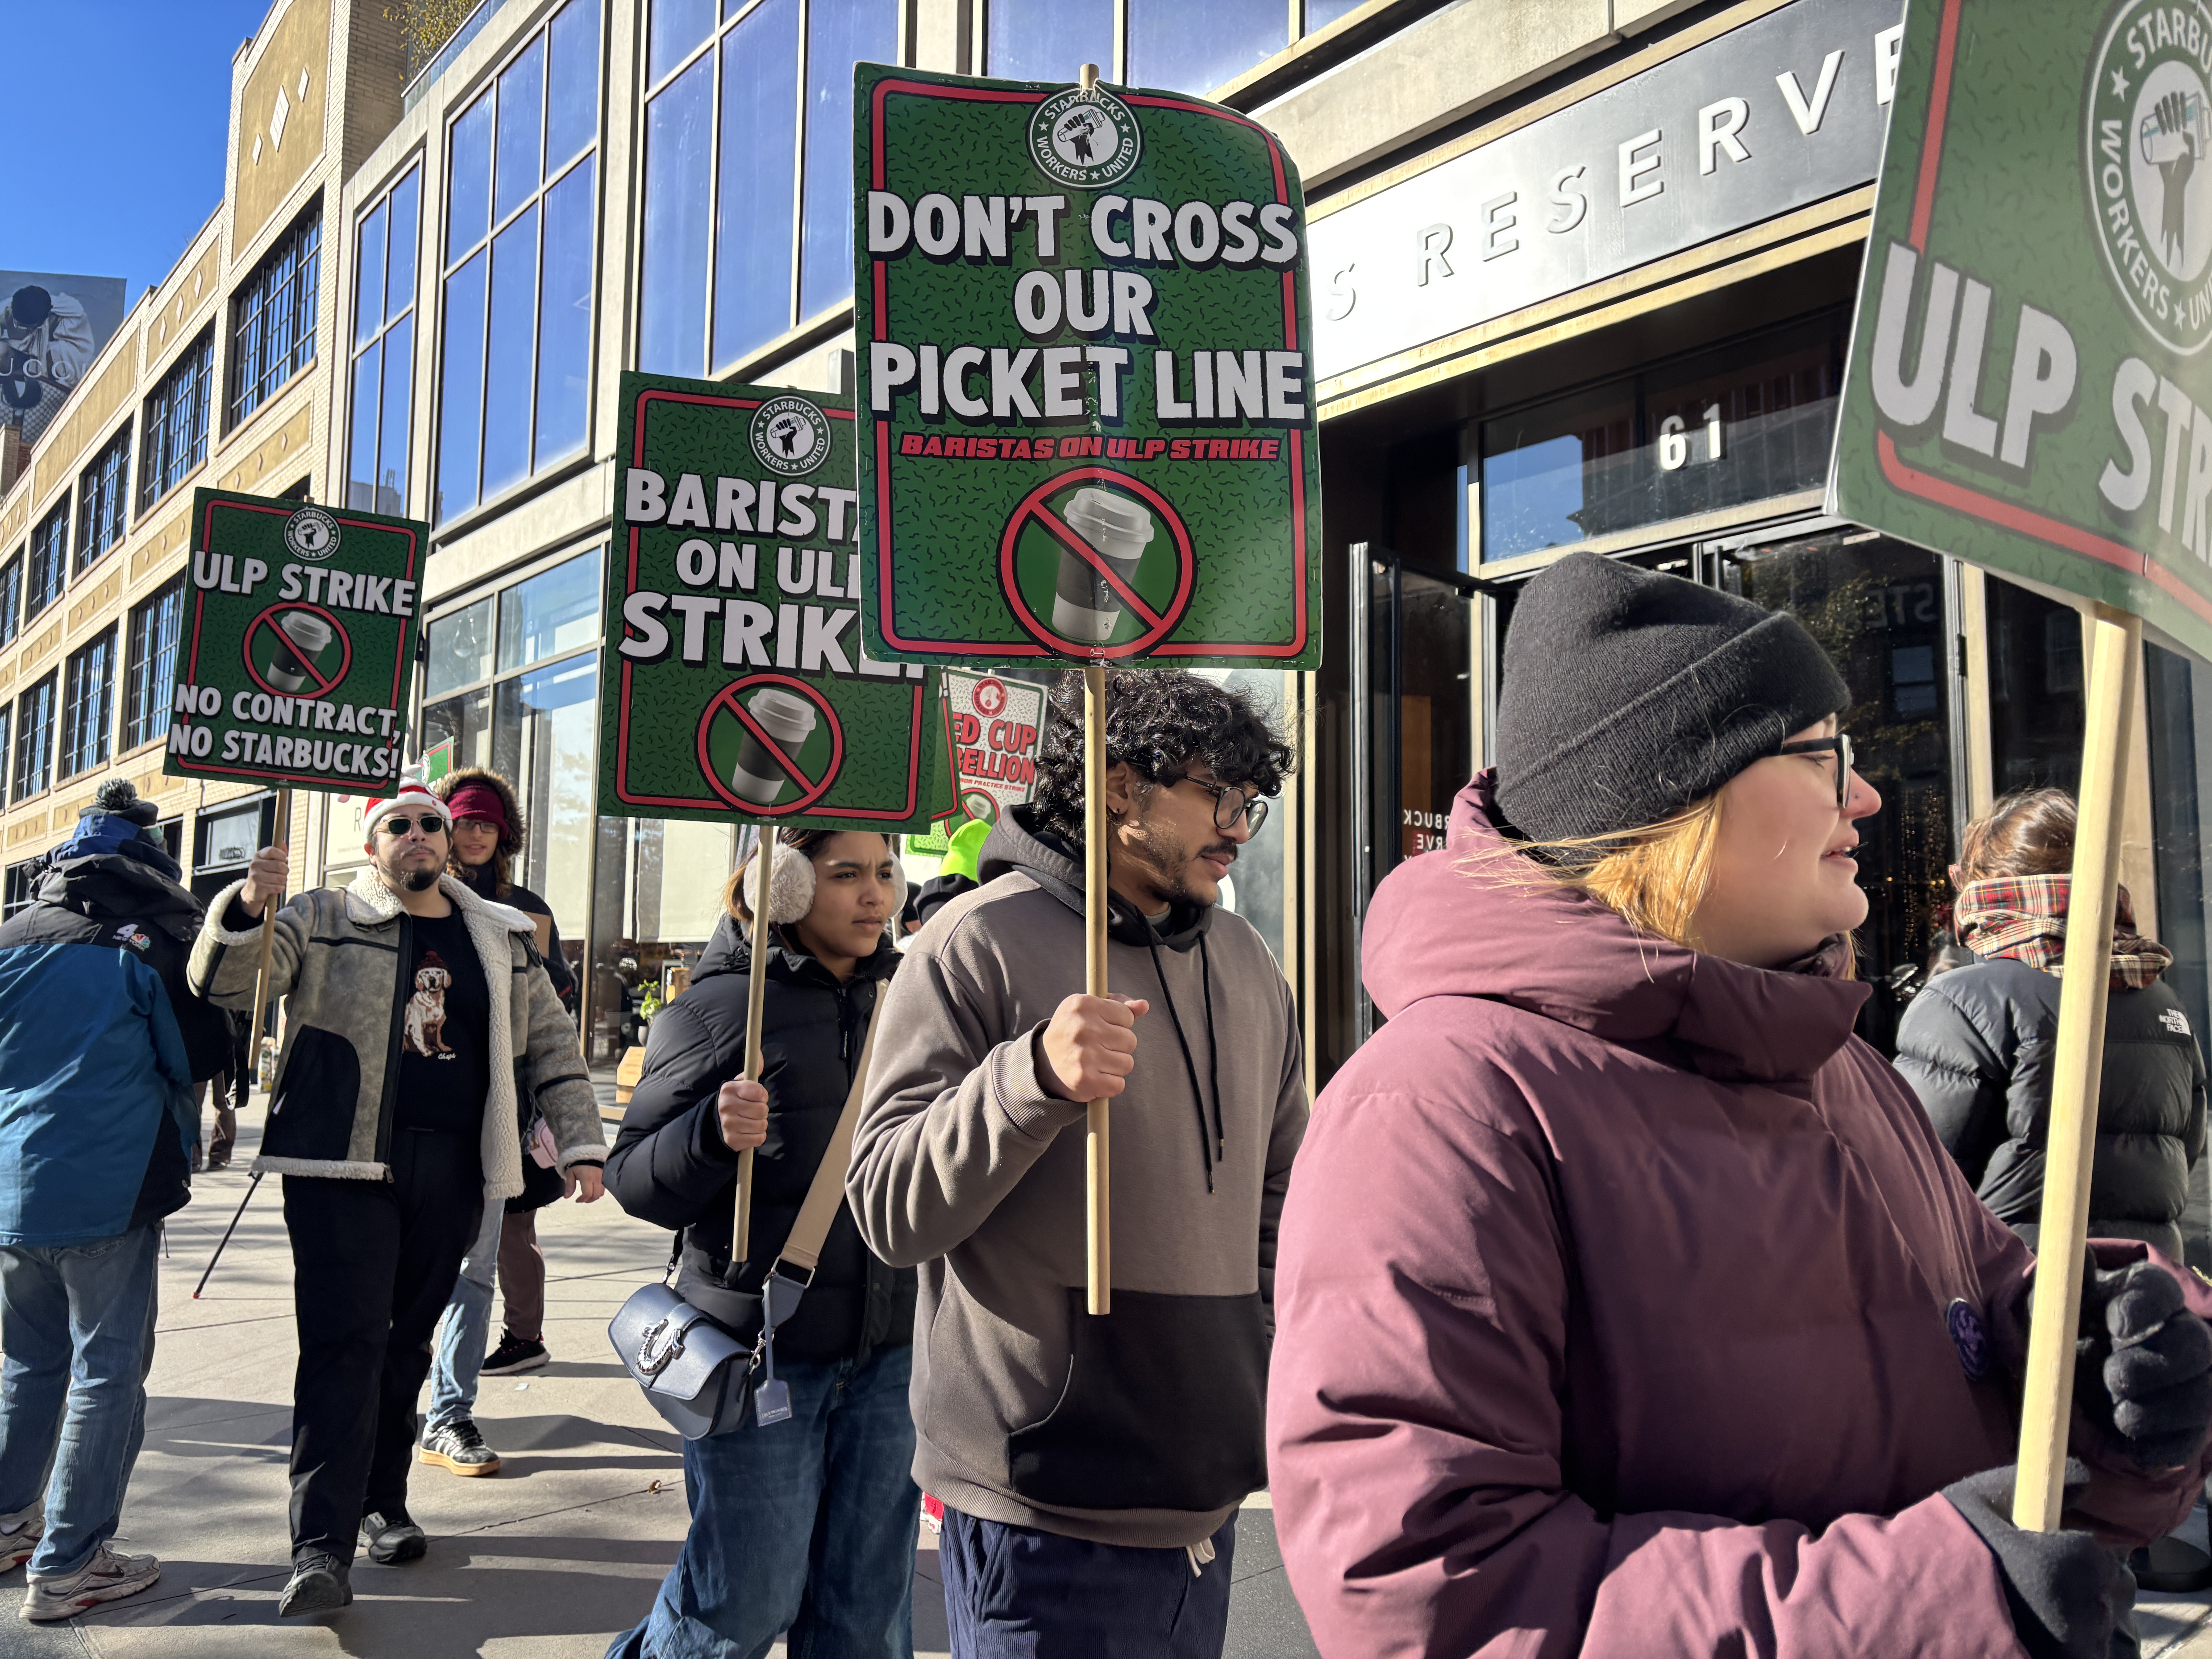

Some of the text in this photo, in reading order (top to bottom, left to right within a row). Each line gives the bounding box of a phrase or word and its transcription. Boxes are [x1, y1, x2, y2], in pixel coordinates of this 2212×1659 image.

[1044, 90, 1125, 121] STARBUCKS
[1037, 136, 1133, 180] WORKERS UNITED
[868, 191, 1298, 263] DON'T CROSS
[2101, 120, 2169, 319] WORKERS
[1015, 270, 1152, 335] OUR
[868, 342, 1305, 419] PICKET LINE
[1872, 241, 2212, 568] ULP STR
[763, 401, 821, 425] STARBUCKS
[1659, 404, 1722, 470] 61
[756, 432, 825, 470] WORKERS UNITED
[901, 435, 1279, 459] BARISTAS ON ULP STRIKE
[294, 511, 334, 529] STARBUCKS
[625, 468, 859, 541] BARIST
[288, 530, 337, 556] WORKERS UNITED
[676, 539, 756, 589] ON
[194, 551, 416, 616] ULP STRIKE
[619, 591, 924, 678] STRIK
[175, 684, 400, 744] NO CONTRACT,
[988, 719, 1037, 753] CUP
[169, 723, 213, 757] NO
[222, 730, 399, 778] STARBUCKS!
